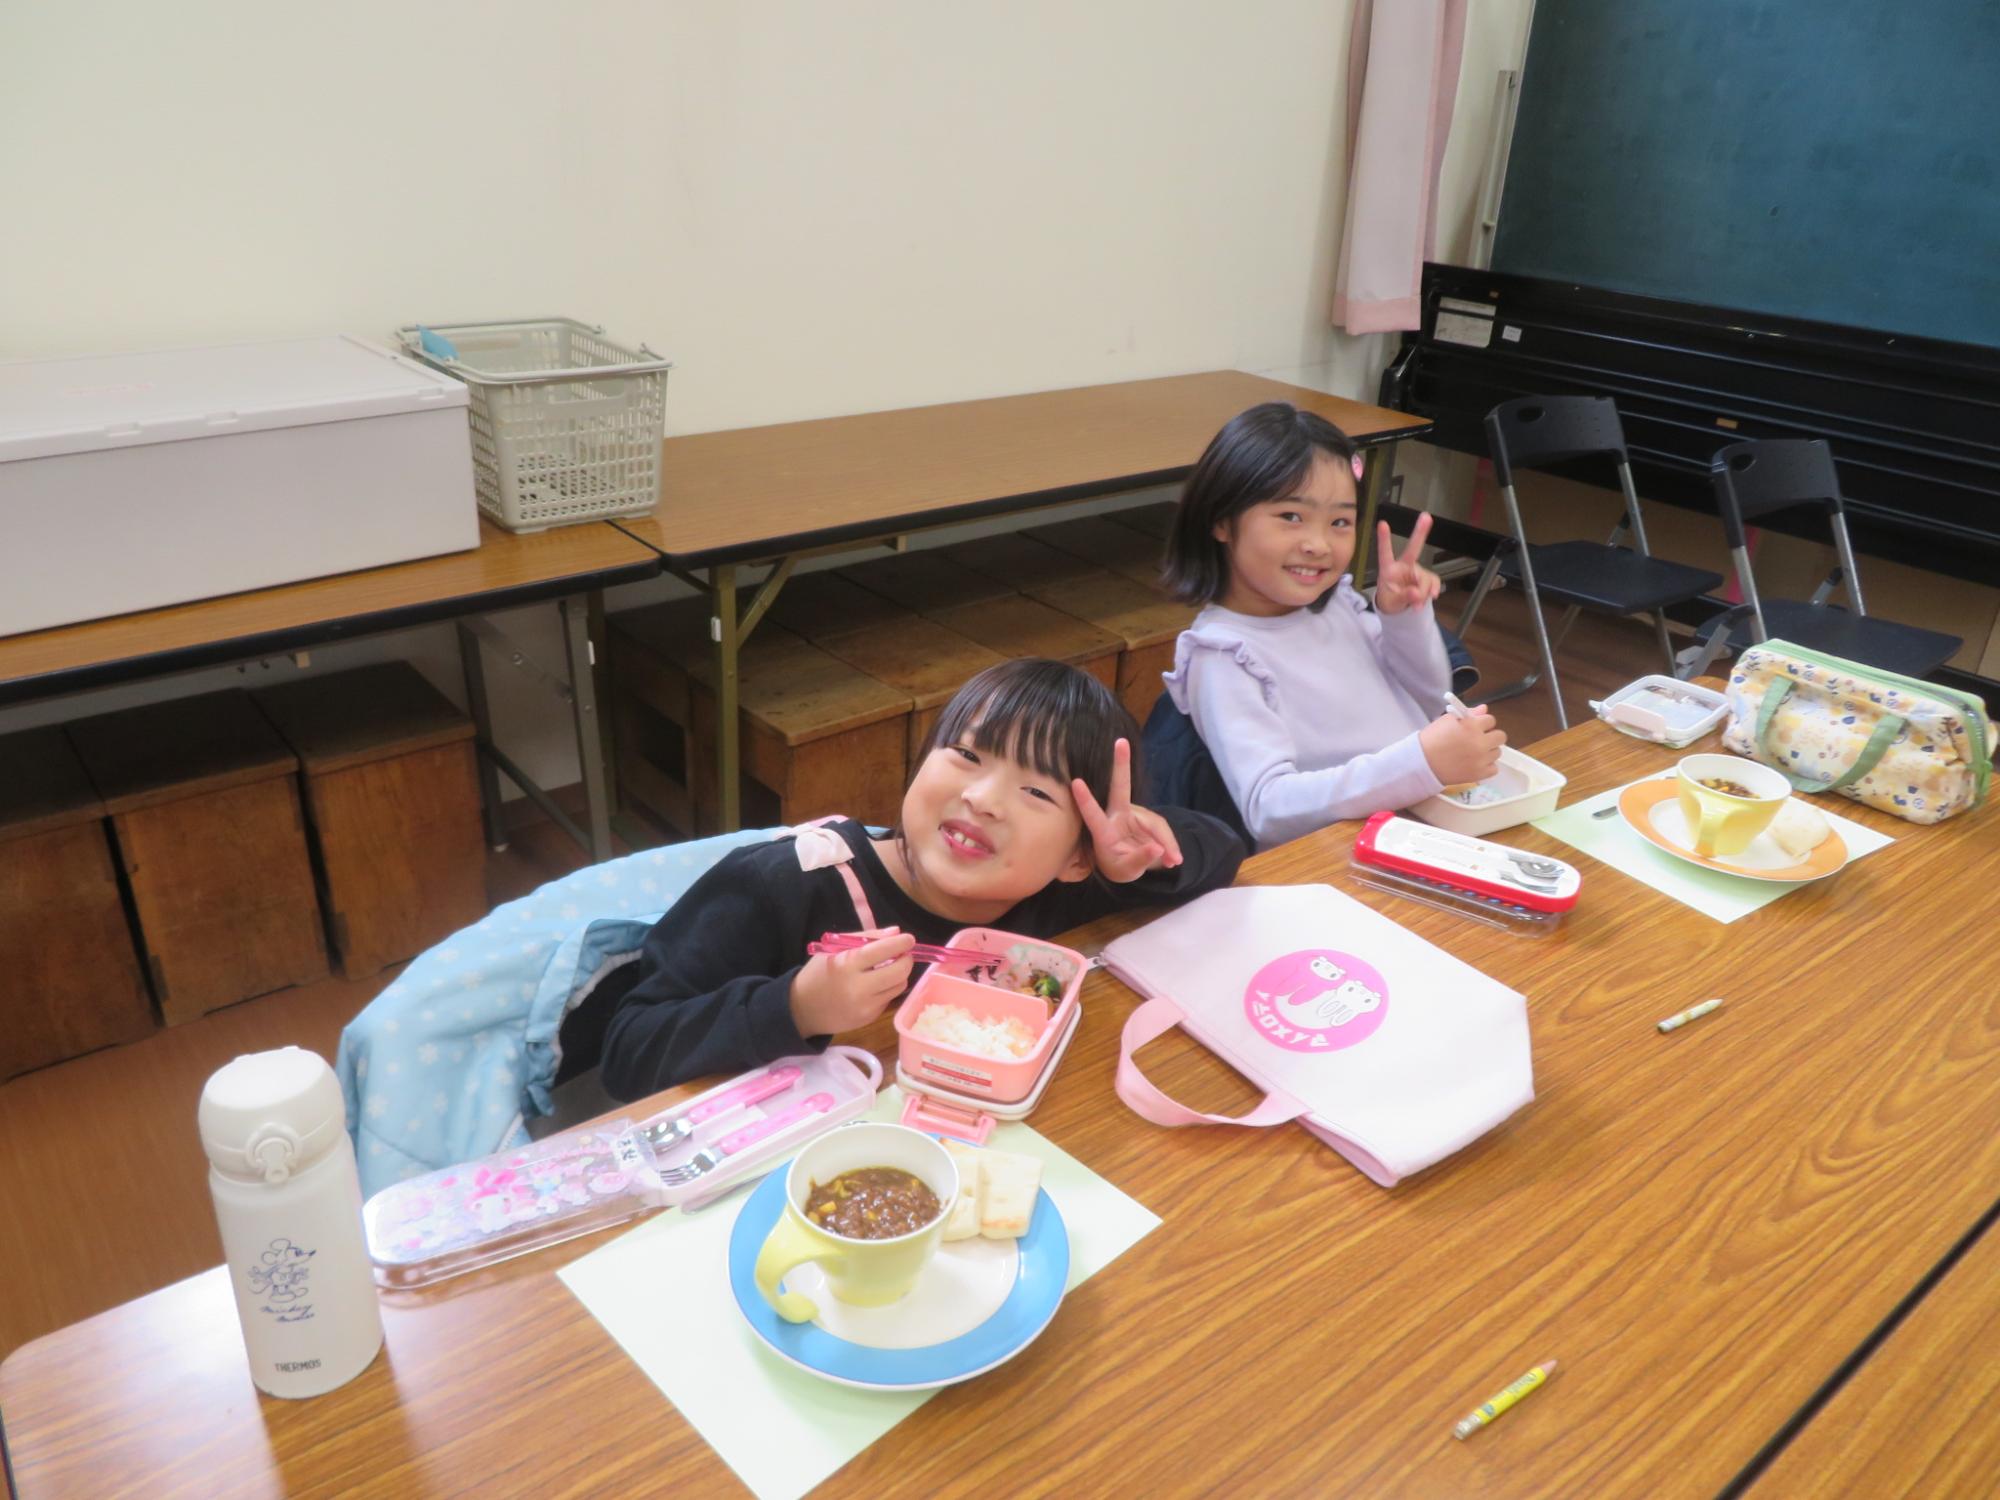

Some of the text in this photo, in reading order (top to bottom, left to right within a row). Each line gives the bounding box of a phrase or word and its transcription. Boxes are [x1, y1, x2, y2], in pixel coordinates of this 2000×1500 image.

[1252, 989, 1330, 1047] マイメロディ
[274, 1358, 321, 1373] THERMOS
